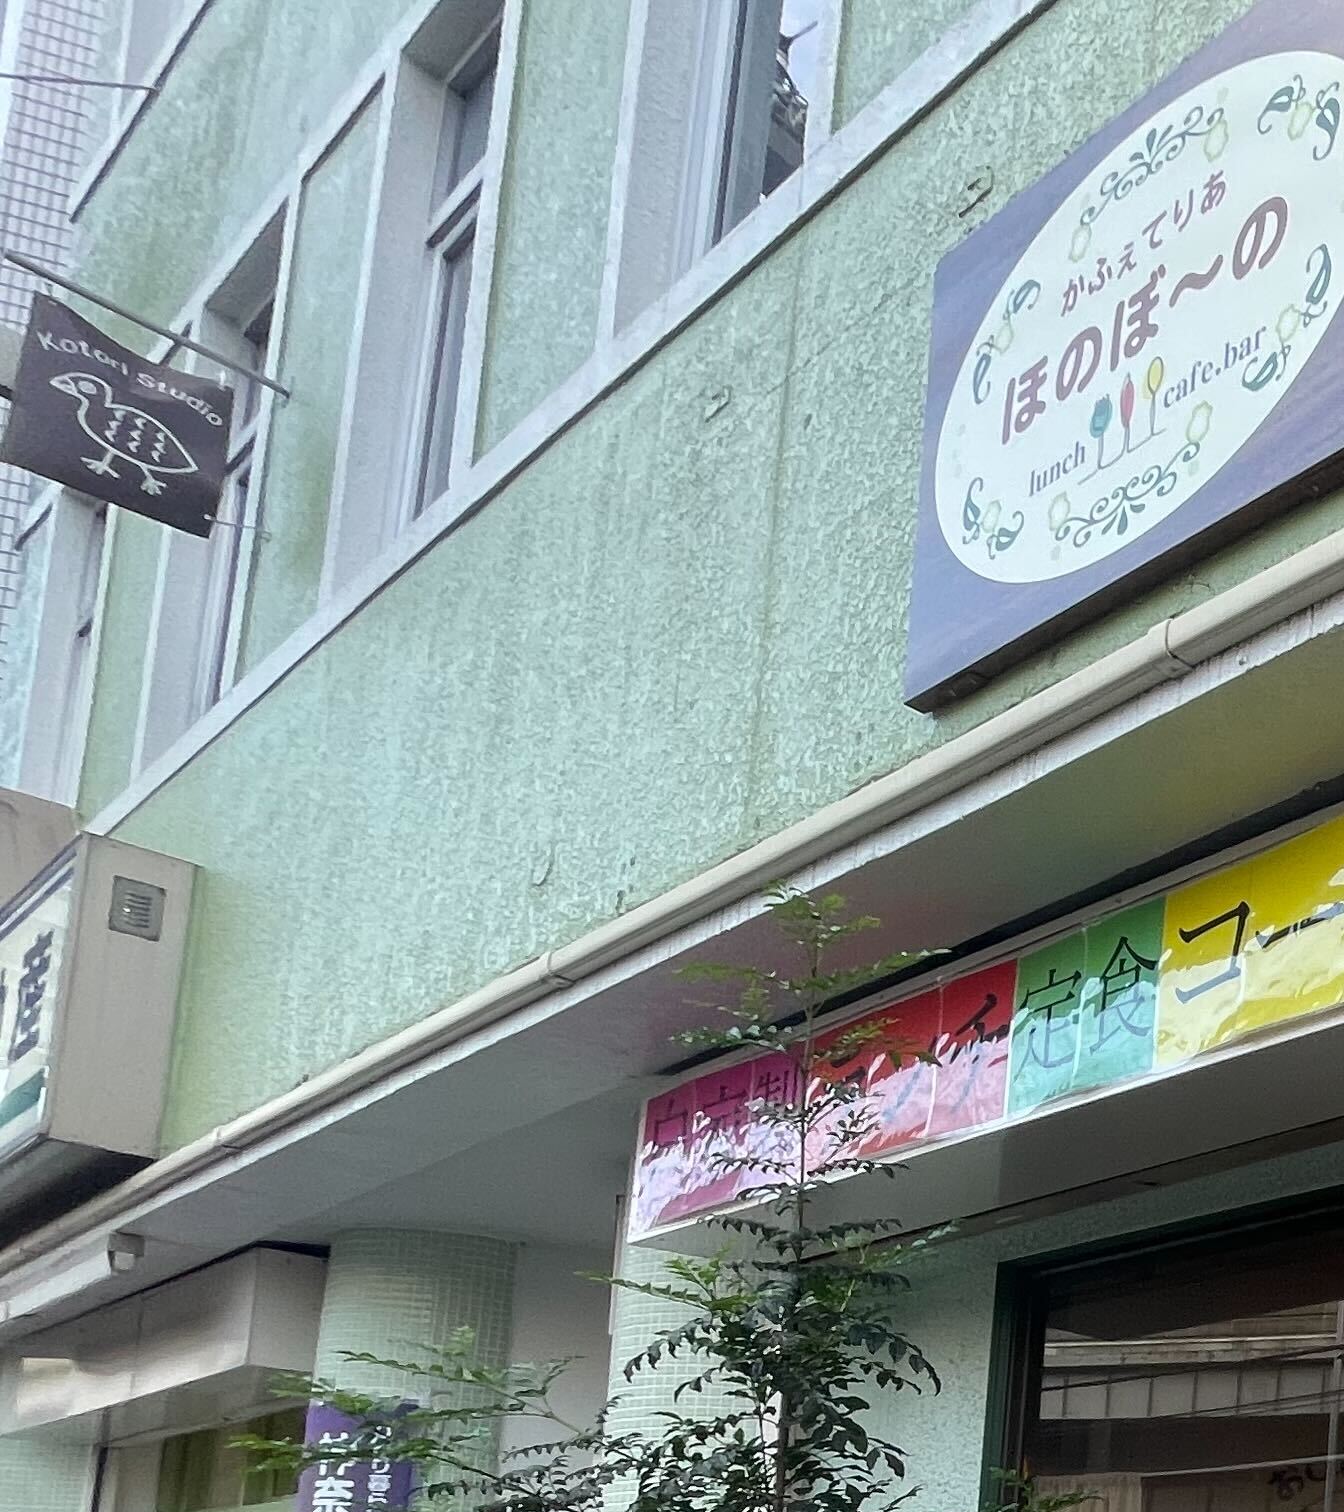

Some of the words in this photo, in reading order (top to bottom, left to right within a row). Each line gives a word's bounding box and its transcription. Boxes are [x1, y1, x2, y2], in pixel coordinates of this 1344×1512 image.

[1061, 170, 1227, 317] かふぇてりあ
[36, 330, 130, 377] Kotori
[136, 372, 224, 427] Studio
[1028, 438, 1087, 498] lunch
[1162, 325, 1269, 410] cafe.bar
[1018, 934, 1159, 1073] 定食
